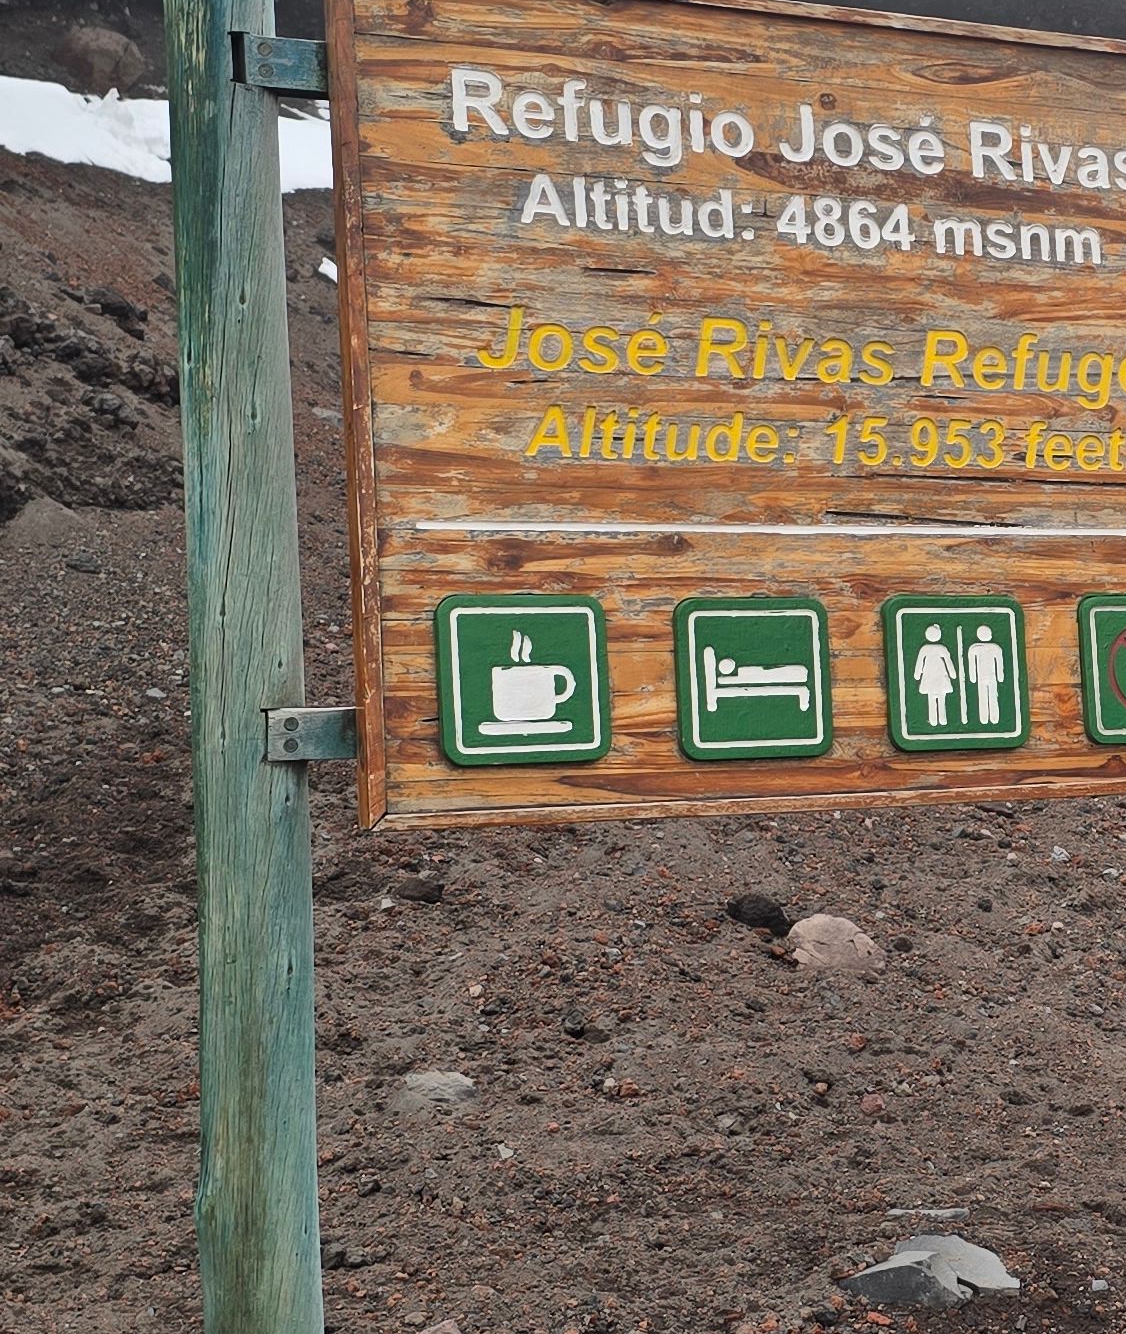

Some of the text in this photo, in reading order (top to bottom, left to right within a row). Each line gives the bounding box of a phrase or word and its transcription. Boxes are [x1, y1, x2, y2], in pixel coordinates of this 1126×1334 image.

[451, 68, 755, 167] Refugio
[778, 103, 945, 175] José
[520, 174, 1101, 265] Altitud: 4864 msnm
[476, 305, 669, 376] José
[695, 316, 896, 386] Rivas
[524, 404, 1126, 471] Altitude: 15.953 feet
